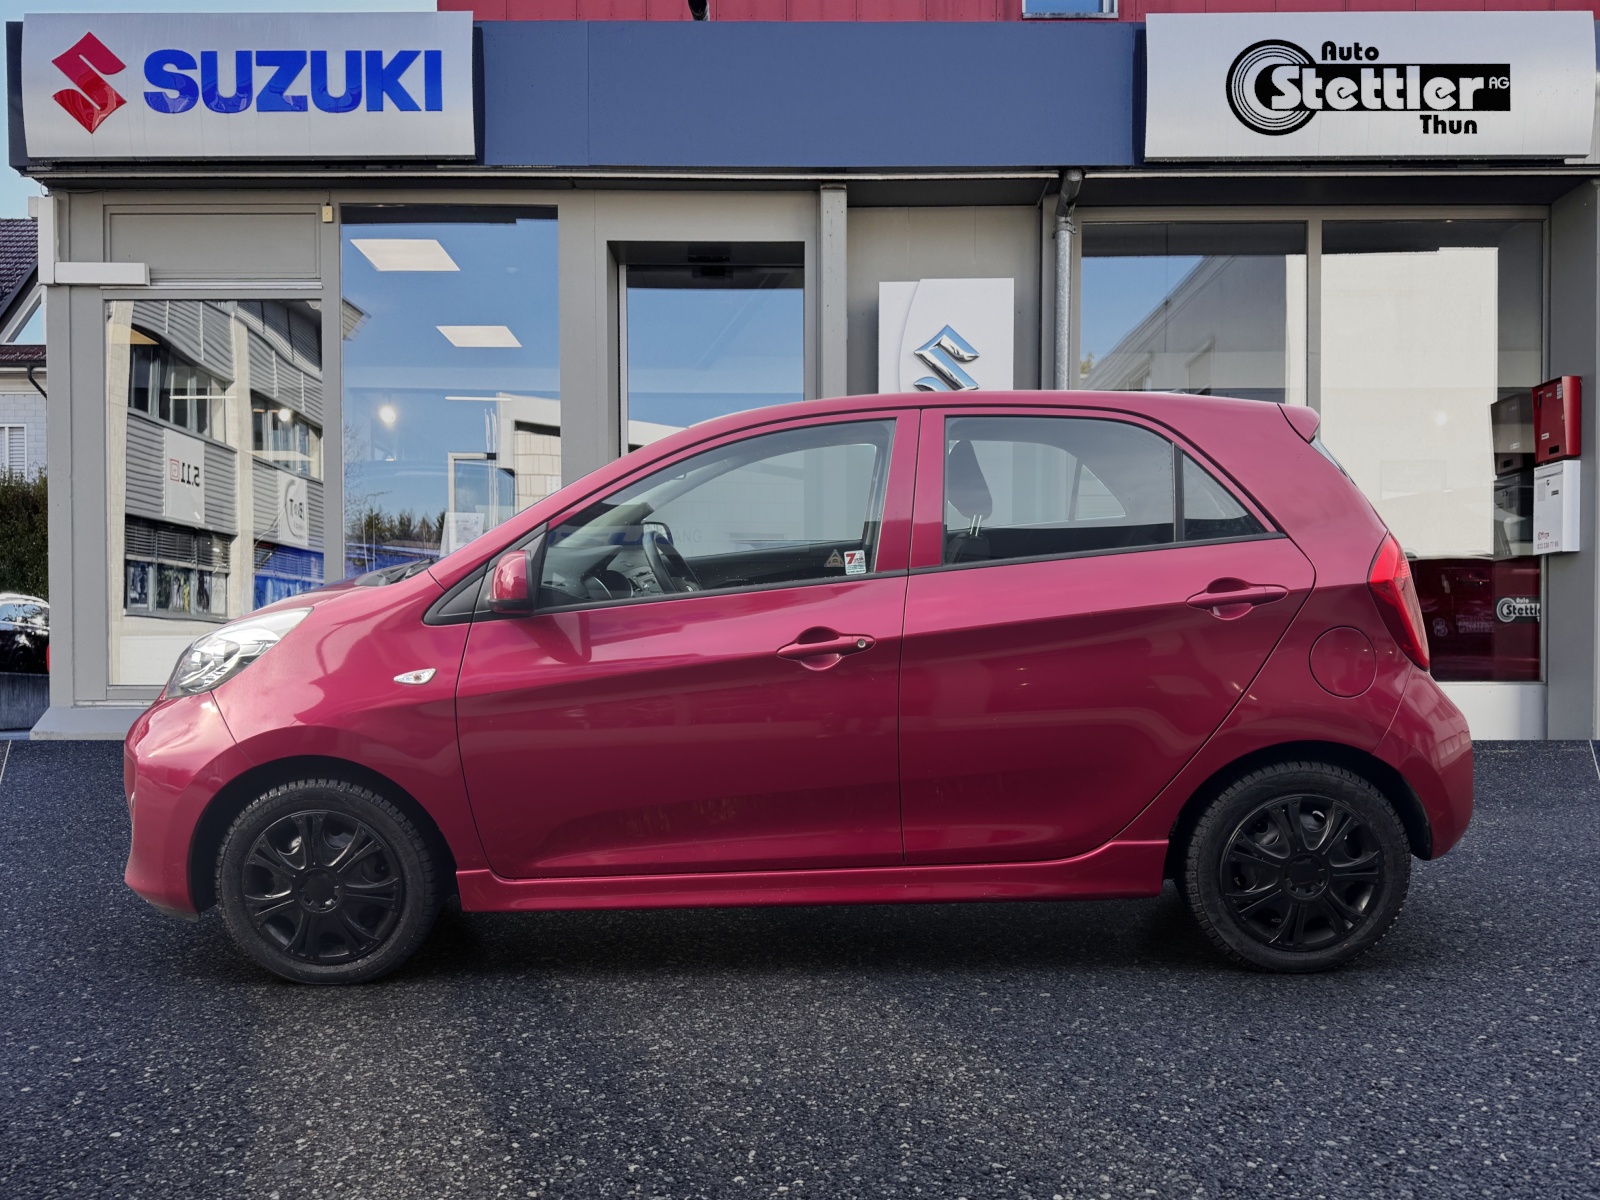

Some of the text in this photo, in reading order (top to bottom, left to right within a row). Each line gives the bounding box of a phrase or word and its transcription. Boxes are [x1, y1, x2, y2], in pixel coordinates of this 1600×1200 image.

[1321, 40, 1379, 61] Auto
[143, 48, 442, 114] SUZUKI
[1271, 65, 1510, 110] Stettler AG
[1420, 114, 1478, 134] Thun
